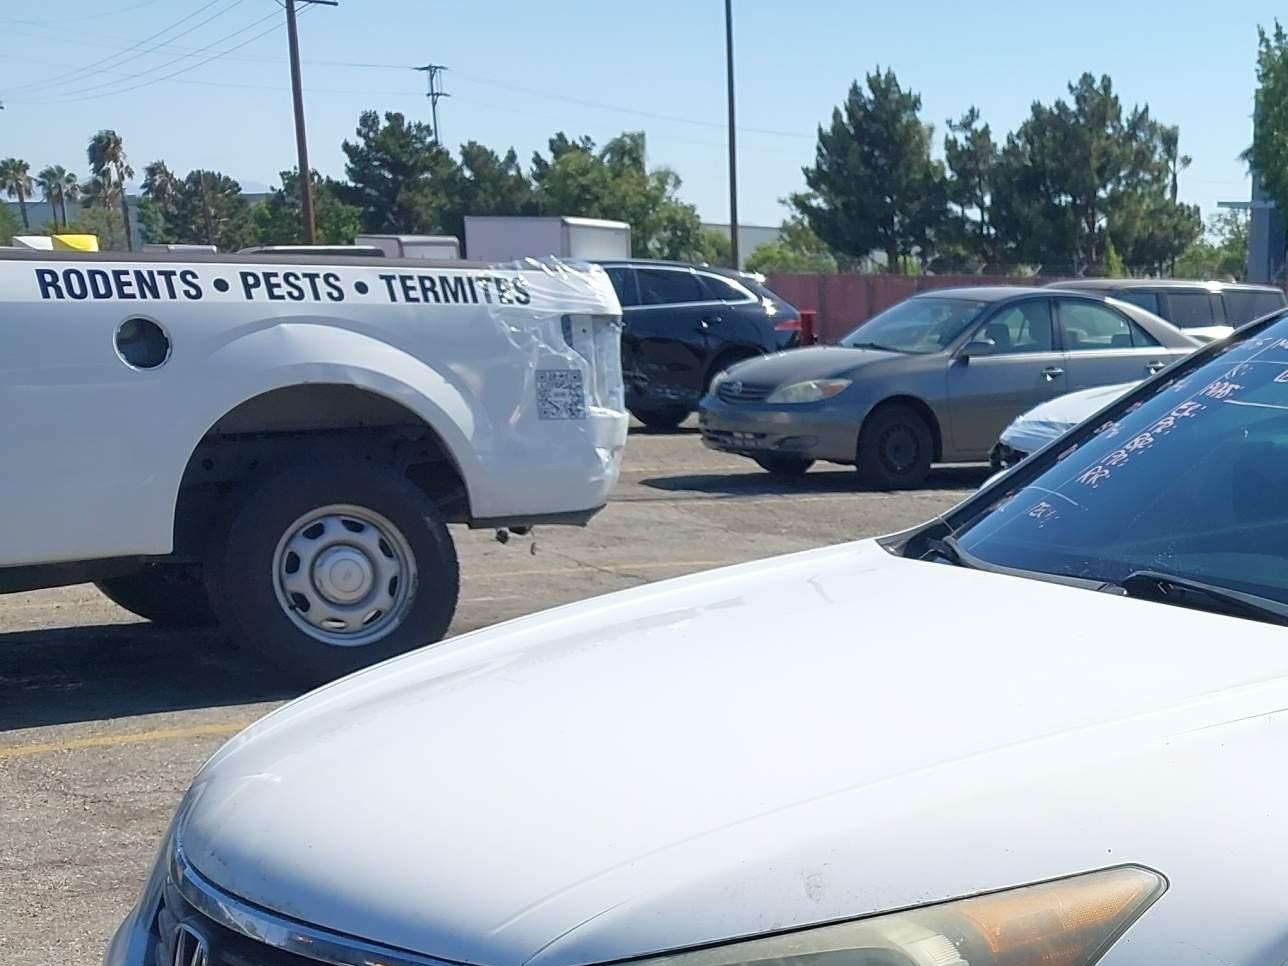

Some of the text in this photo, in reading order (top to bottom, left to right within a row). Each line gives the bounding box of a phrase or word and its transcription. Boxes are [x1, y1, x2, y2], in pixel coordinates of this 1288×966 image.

[35, 267, 531, 305] RODENTS PESTS TERMITES
